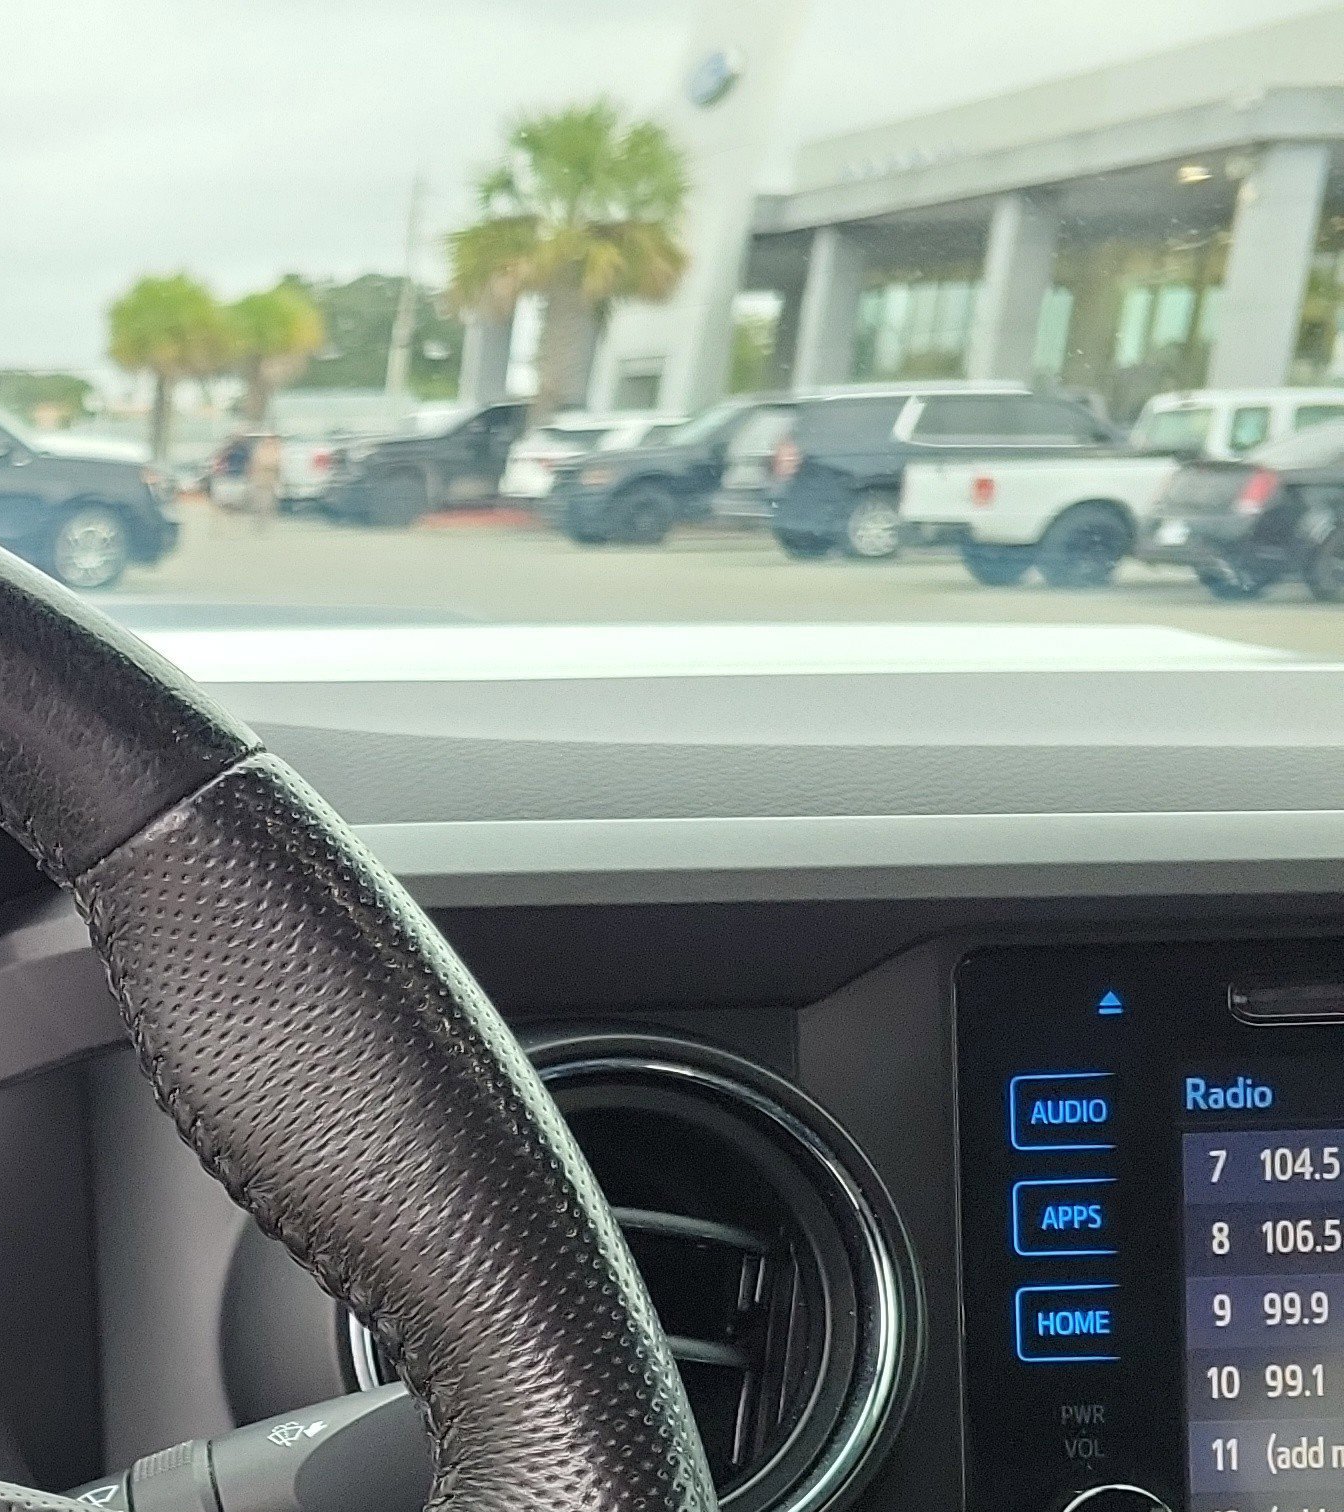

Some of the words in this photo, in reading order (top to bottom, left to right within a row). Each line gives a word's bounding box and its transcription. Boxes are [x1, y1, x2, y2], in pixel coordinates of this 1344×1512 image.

[1185, 1076, 1273, 1111] Radio
[1030, 1100, 1108, 1124] AUDIO
[1209, 1150, 1227, 1183] 7
[1260, 1147, 1341, 1182] 104.5
[1041, 1205, 1102, 1230] APPS
[1212, 1222, 1230, 1255] 8
[1261, 1219, 1342, 1254] 106.5
[1037, 1310, 1110, 1336] HOME
[1213, 1294, 1231, 1327] 9
[1263, 1291, 1330, 1326] 99.9
[1207, 1365, 1240, 1400] 10
[1264, 1363, 1325, 1398] 99.1
[1062, 1404, 1105, 1425] PWR
[1065, 1439, 1105, 1458] VOL
[1212, 1438, 1239, 1472] 11
[1266, 1432, 1325, 1475] (add
